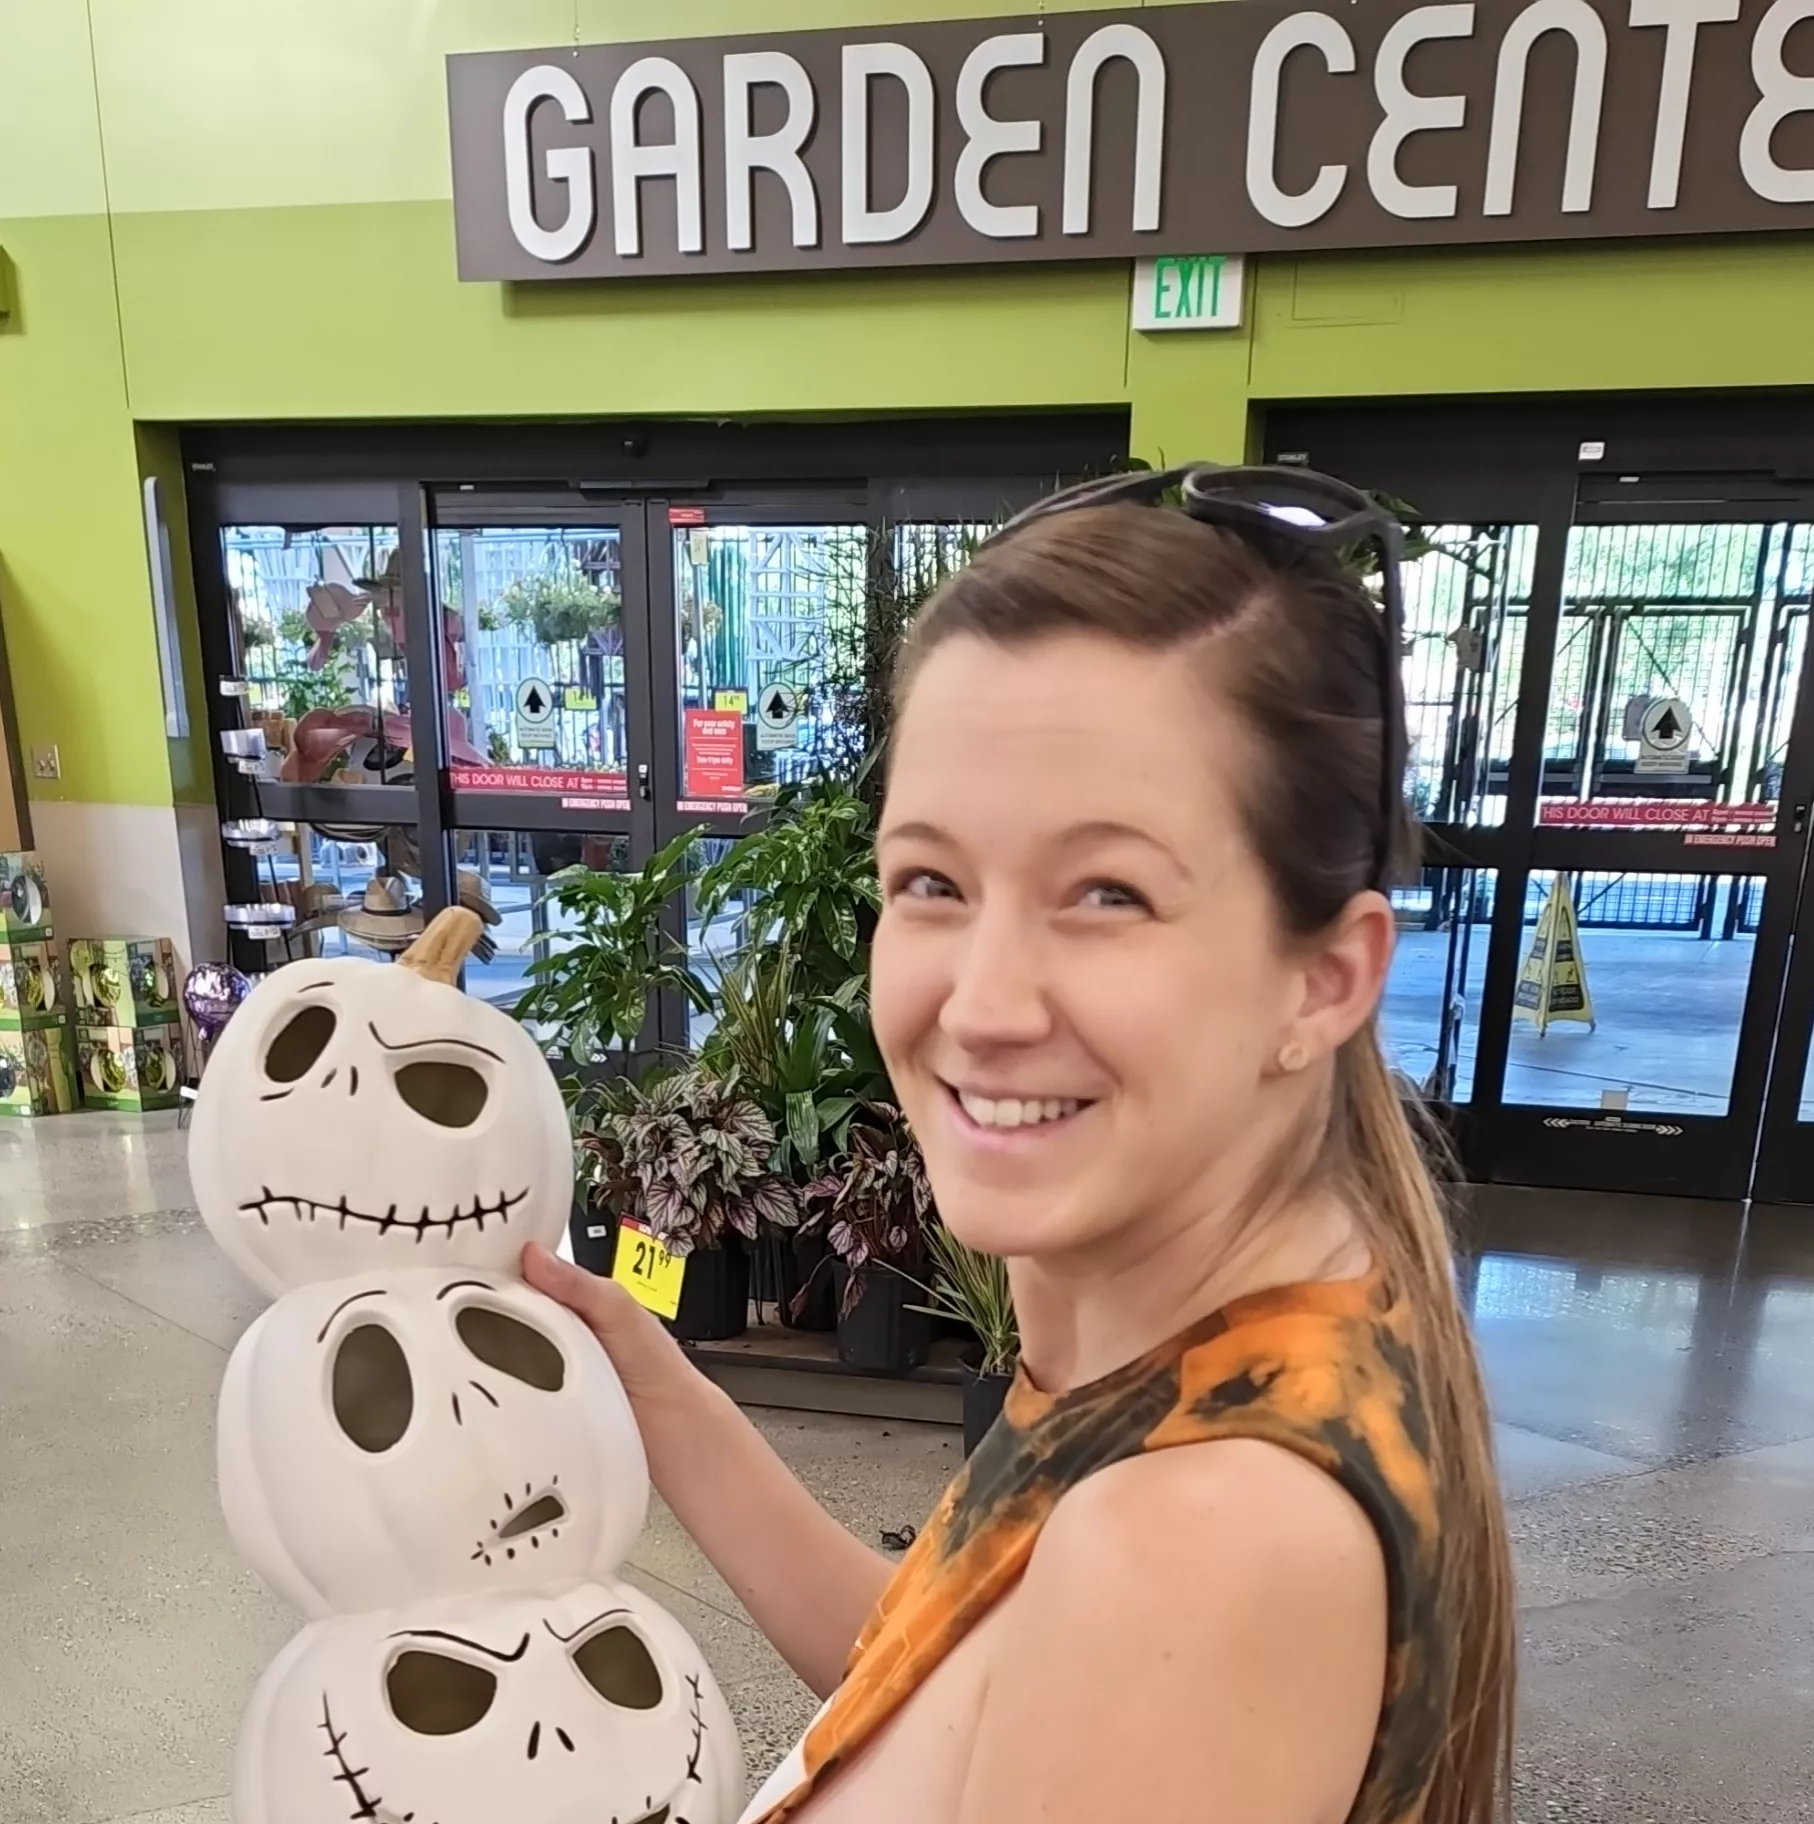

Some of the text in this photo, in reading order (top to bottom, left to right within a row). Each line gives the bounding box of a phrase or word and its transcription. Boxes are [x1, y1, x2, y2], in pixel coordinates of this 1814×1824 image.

[503, 24, 1166, 262] GARDEN
[1154, 256, 1226, 318] EXIT
[472, 773, 504, 785] DOOR
[505, 774, 528, 787] WILL
[531, 775, 563, 788] CLOSE
[566, 777, 579, 789] AT
[1542, 806, 1564, 819] HIS
[1567, 807, 1609, 819] DOOR
[1612, 807, 1641, 820] WILL
[1645, 808, 1689, 821] CLOSE
[1692, 809, 1710, 821] AT
